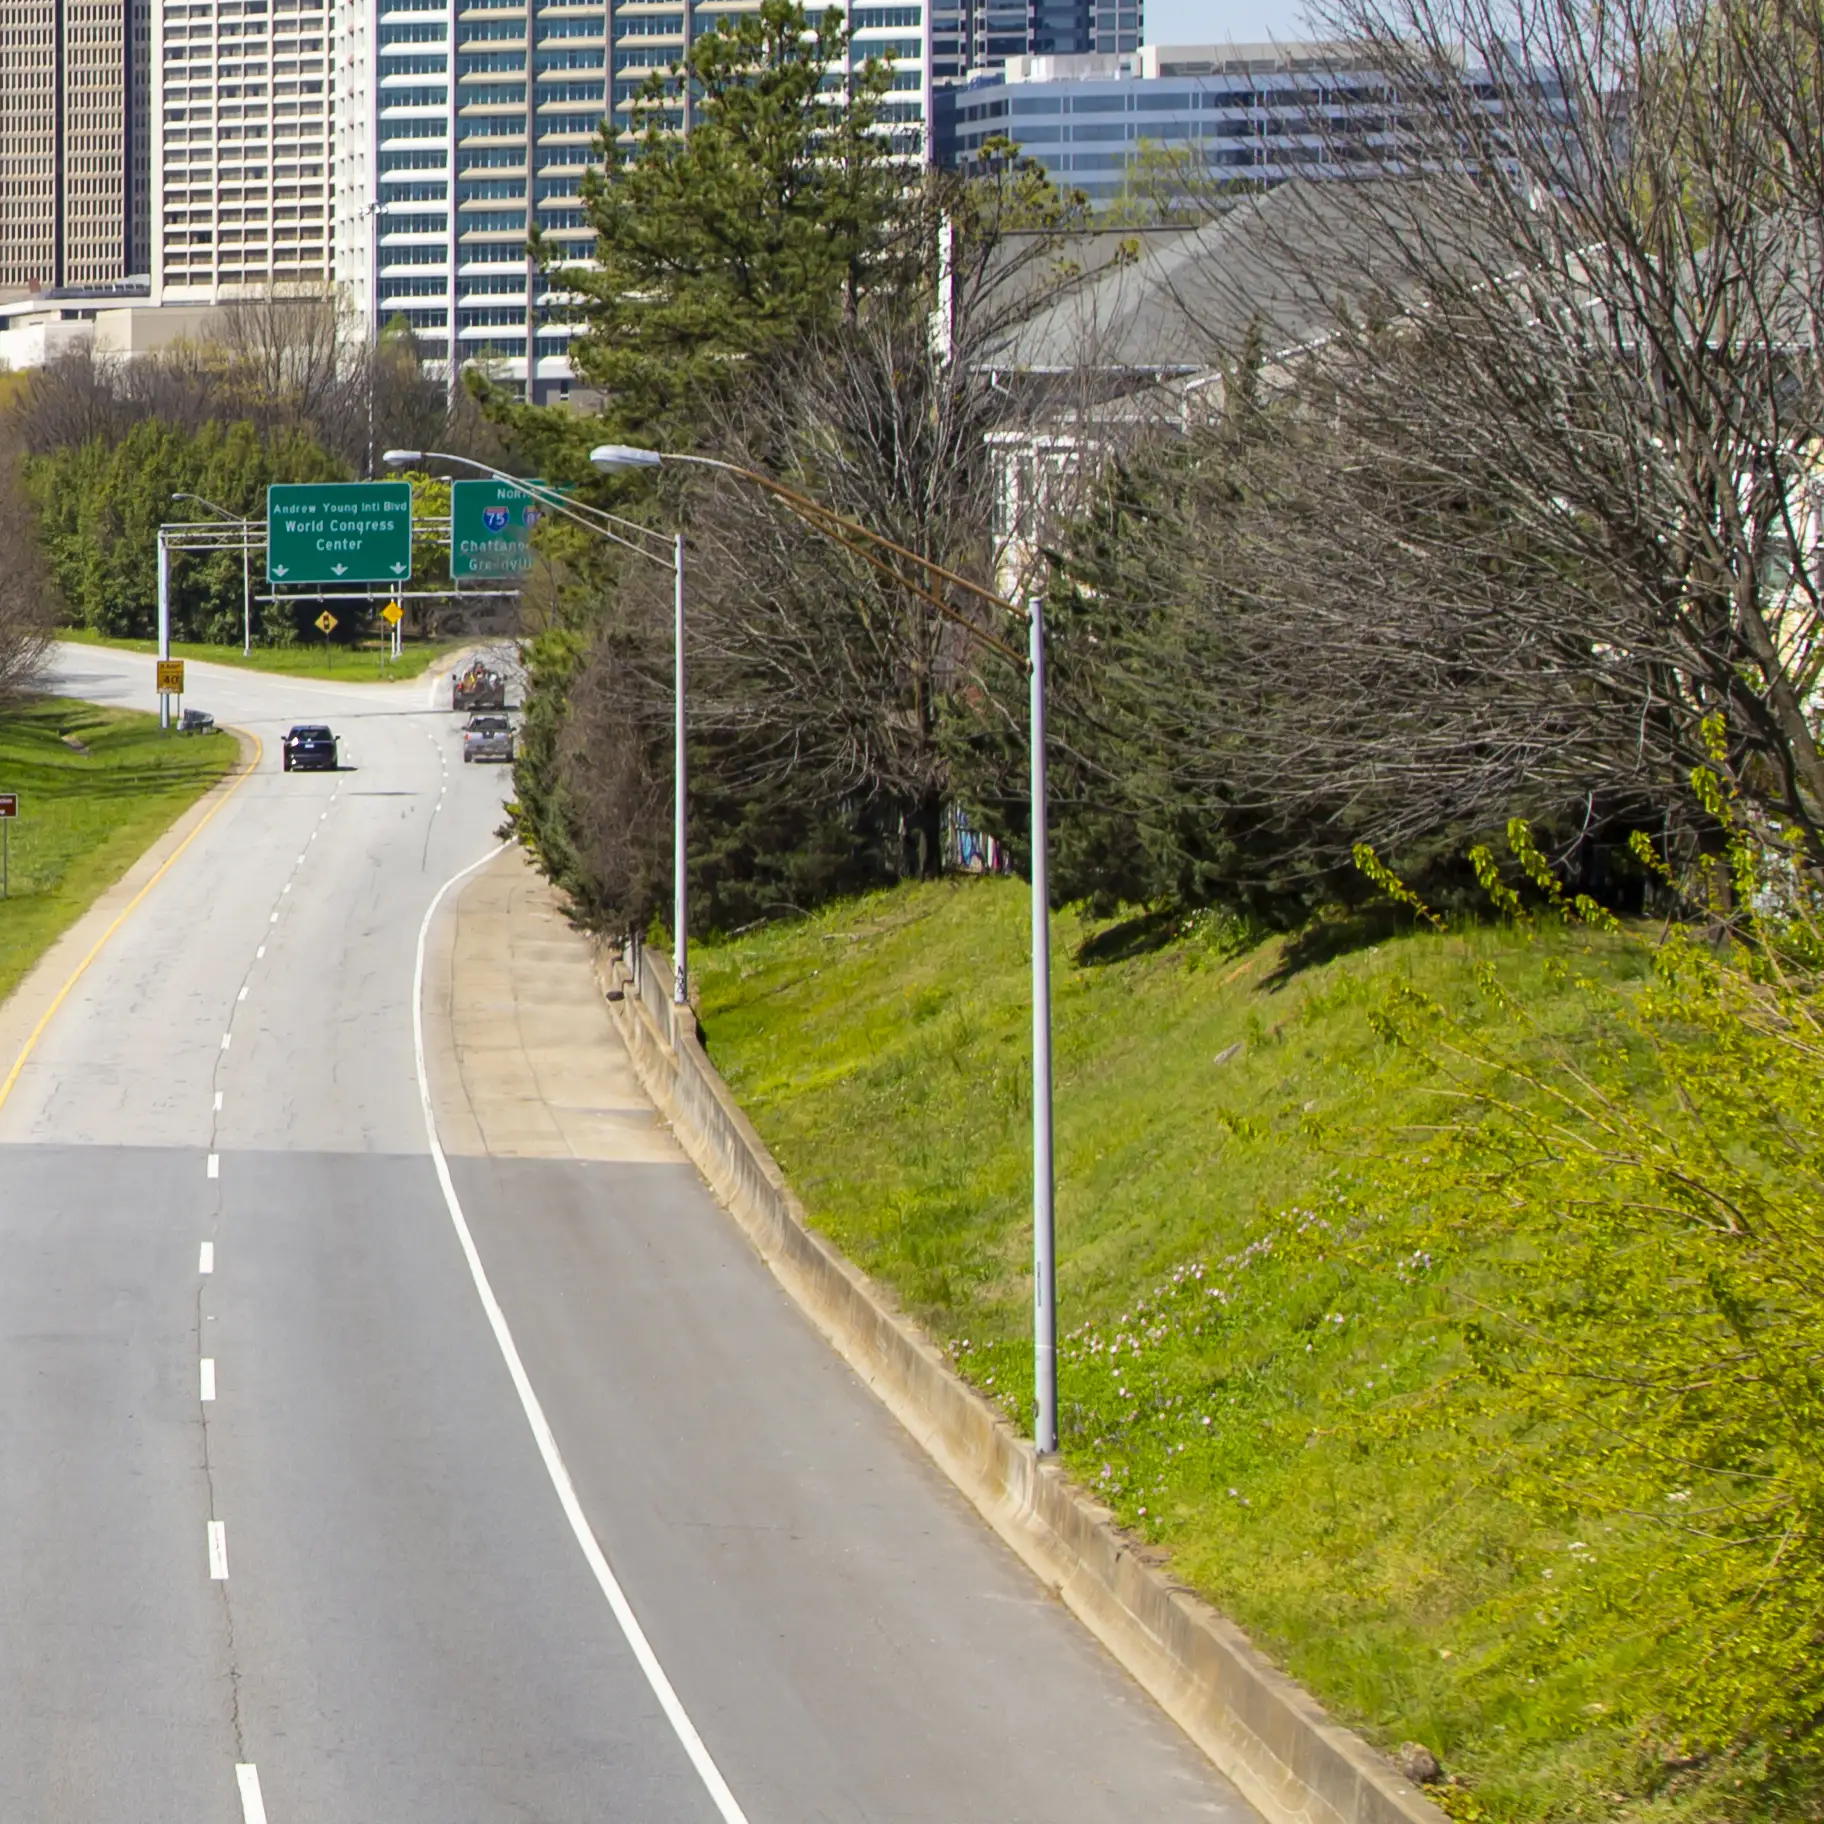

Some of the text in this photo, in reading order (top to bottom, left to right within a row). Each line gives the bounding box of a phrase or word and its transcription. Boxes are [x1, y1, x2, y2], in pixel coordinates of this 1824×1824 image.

[273, 501, 407, 515] Andrew Young Intl Blvd
[487, 512, 505, 526] 75
[285, 519, 395, 535] World Congress
[316, 538, 363, 551] Center
